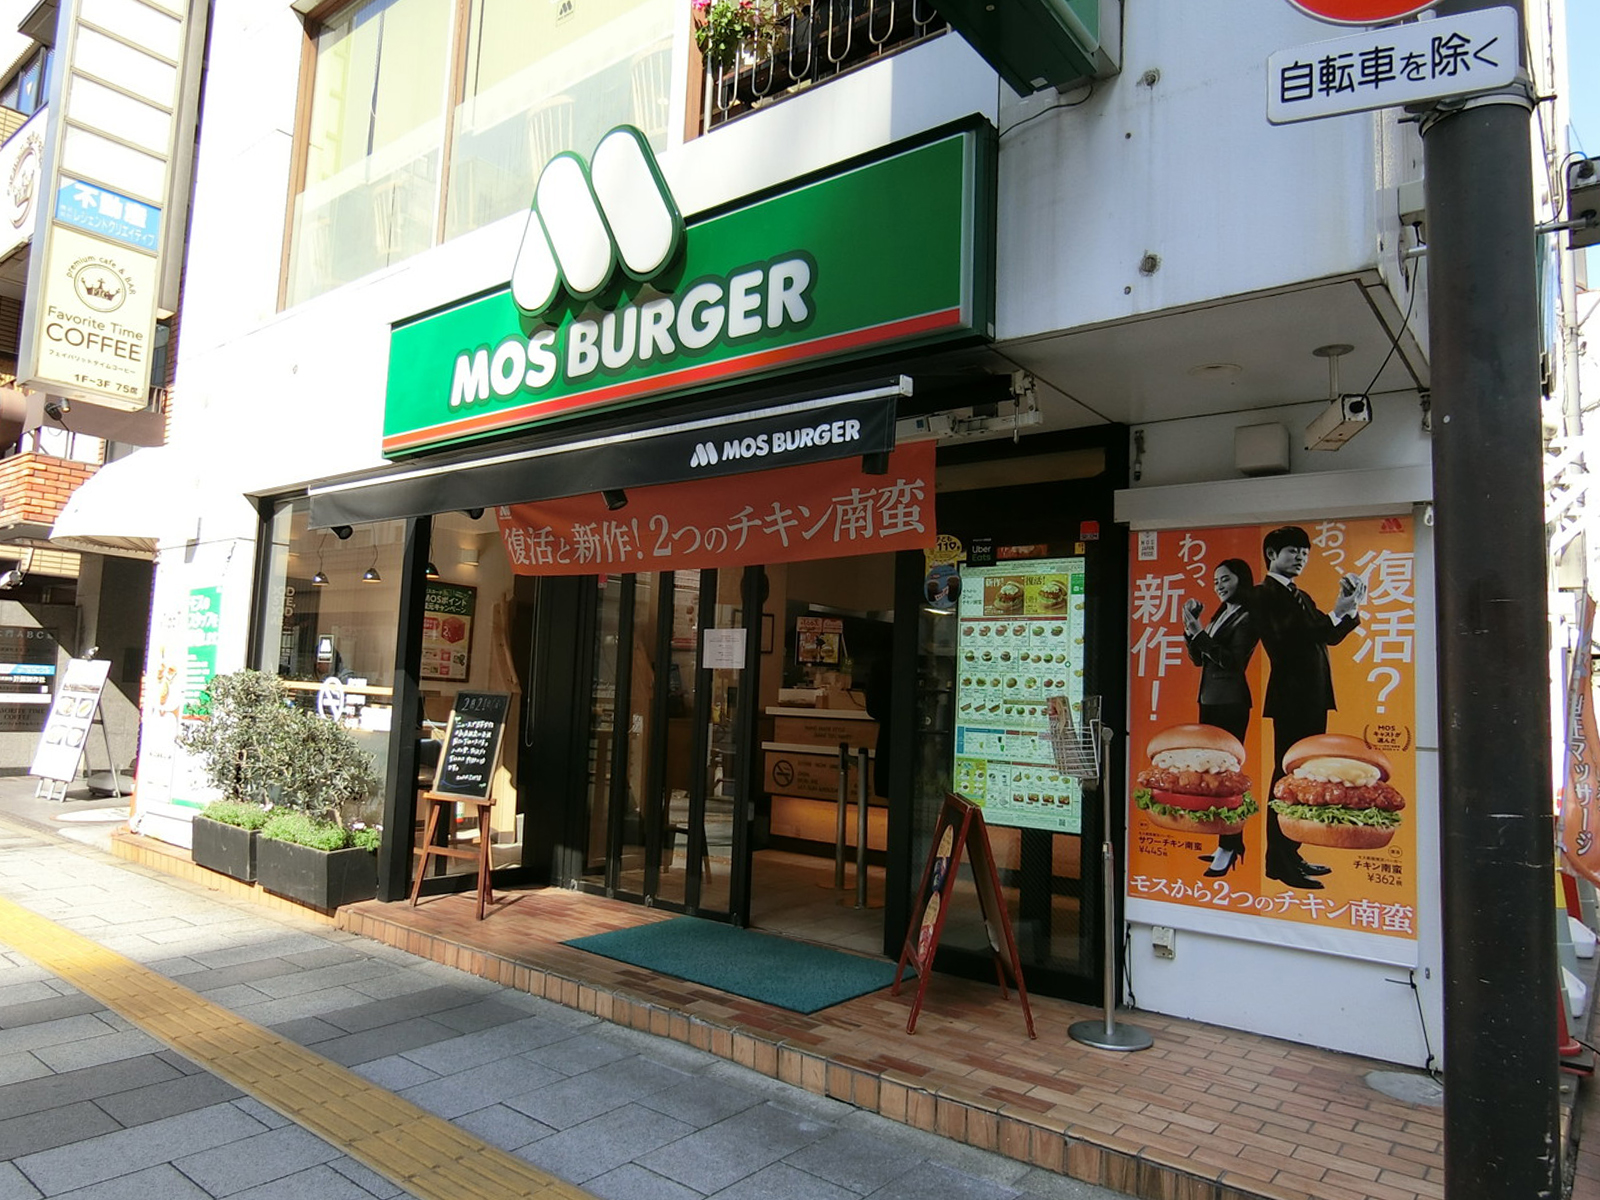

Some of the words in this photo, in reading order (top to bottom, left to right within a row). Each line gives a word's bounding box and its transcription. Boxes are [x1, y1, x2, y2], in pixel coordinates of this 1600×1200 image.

[1280, 32, 1499, 104] 自転車を除く
[66, 256, 95, 279] premium
[99, 257, 116, 268] cafe
[125, 276, 136, 295] BAR
[46, 322, 143, 362] COFFEE
[47, 305, 106, 331] Favorite
[110, 321, 143, 341] Time
[451, 329, 557, 408] MOS
[567, 258, 812, 380] BURGER
[722, 435, 769, 462] MOS
[772, 419, 861, 454] BURGER
[971, 545, 992, 553] Uber
[971, 554, 991, 562] Eats
[1177, 533, 1207, 588] わっ、
[1312, 521, 1346, 575] おっ、
[1130, 572, 1187, 721] 新作!
[1352, 550, 1416, 714] 復活?
[1138, 836, 1203, 851] サワーチキン南蛮
[1353, 860, 1403, 874] チキン南蛮
[1129, 875, 1414, 936] モスから2つのチキン南蛮
